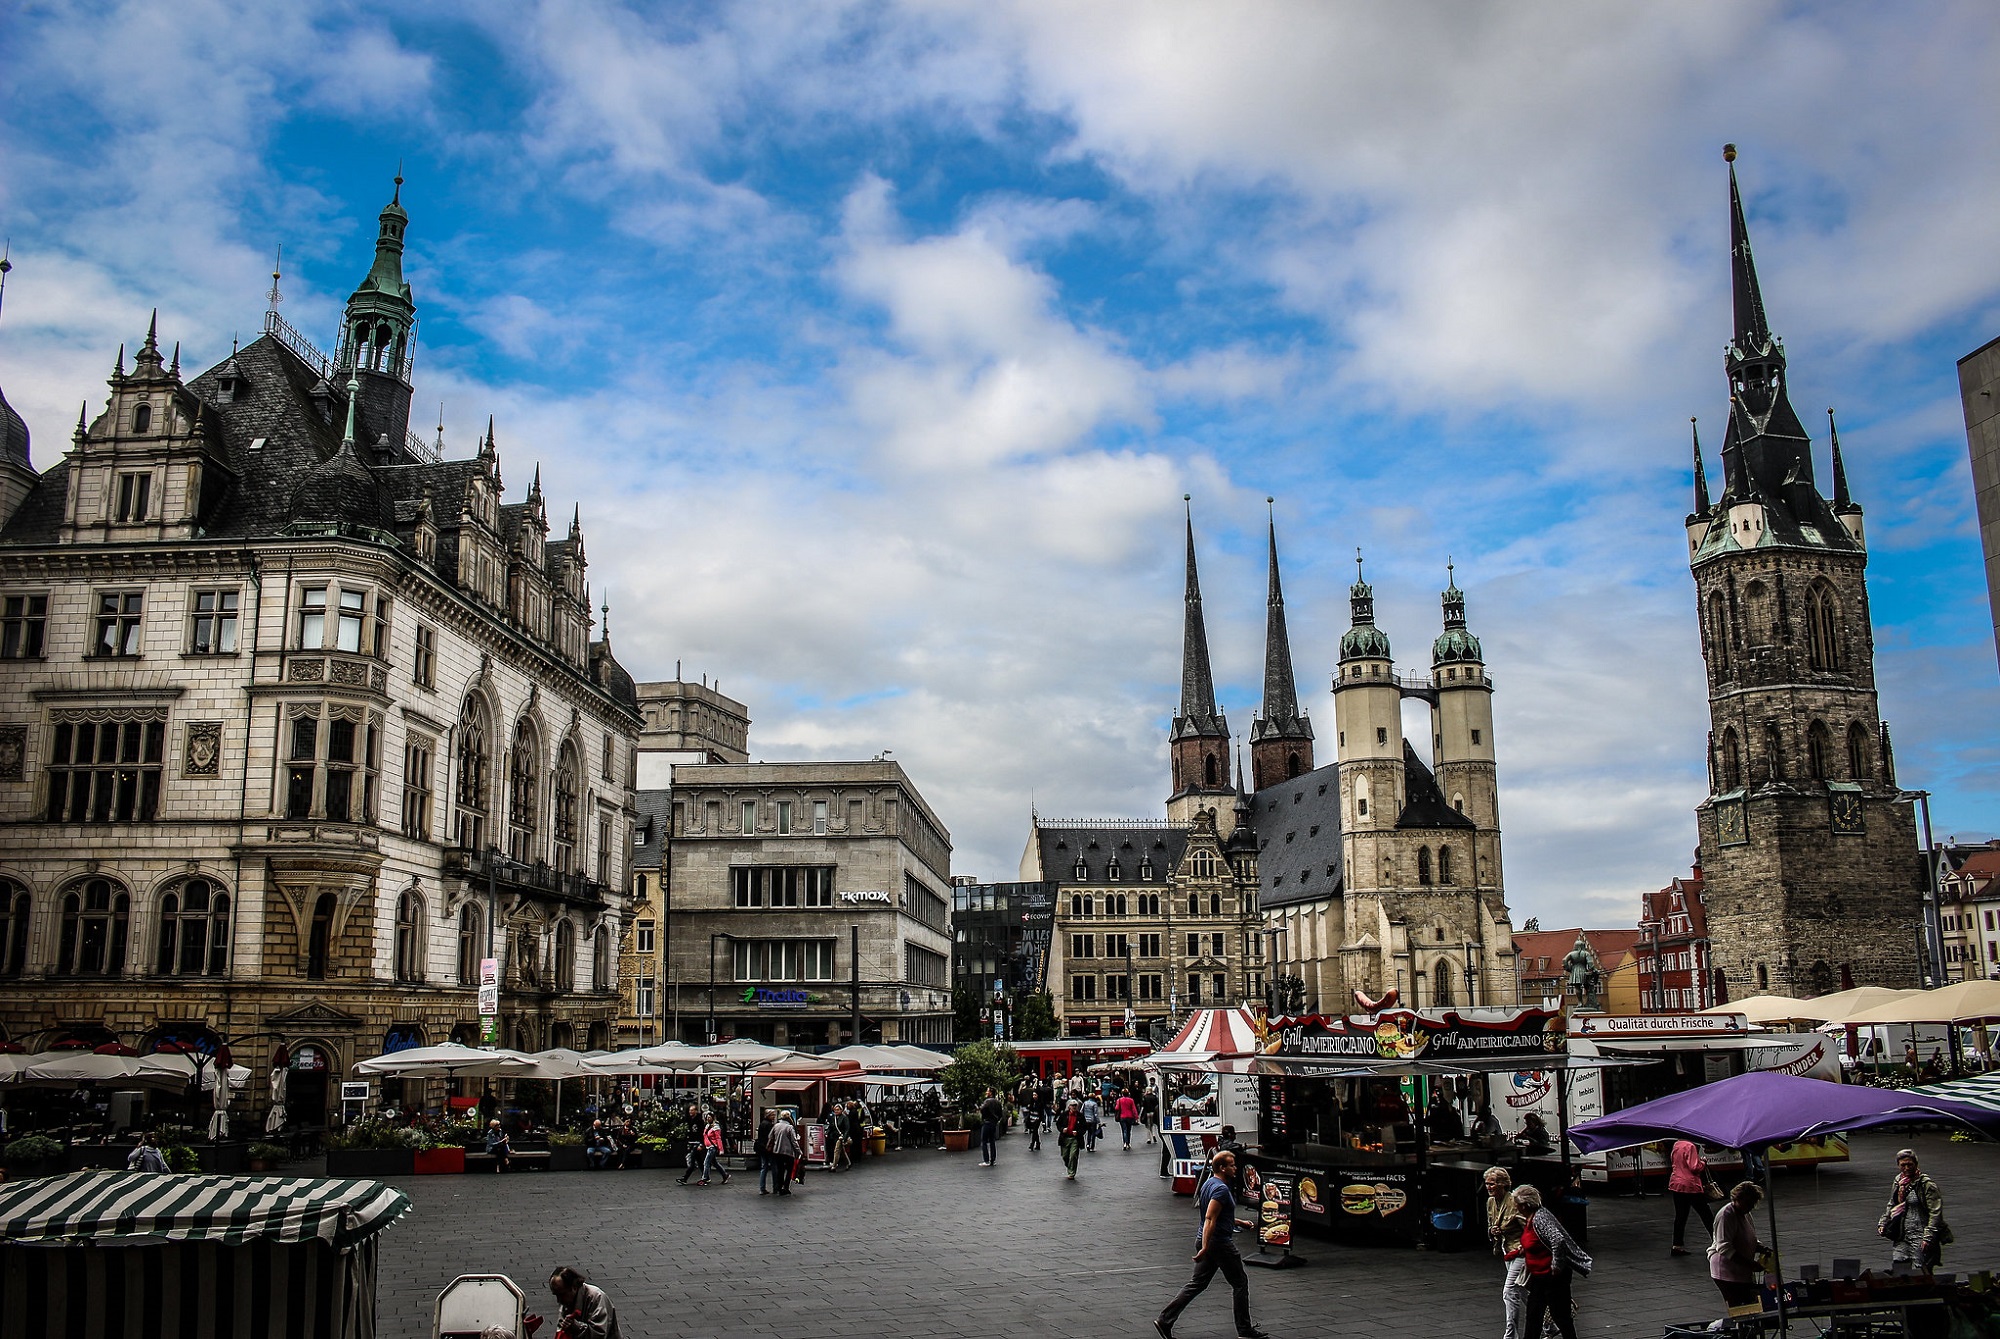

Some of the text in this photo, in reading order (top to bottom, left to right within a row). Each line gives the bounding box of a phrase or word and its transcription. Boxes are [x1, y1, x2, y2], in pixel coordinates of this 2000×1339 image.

[1608, 1017, 1714, 1031] Qualität durch Frische
[1282, 1025, 1376, 1055] Grill AMERICANO
[1432, 1031, 1541, 1051] Grill AMERICANO
[1767, 1051, 1819, 1076] RLÄNDER
[1578, 1088, 1595, 1097] Imbiss
[1579, 1103, 1596, 1113] Salate
